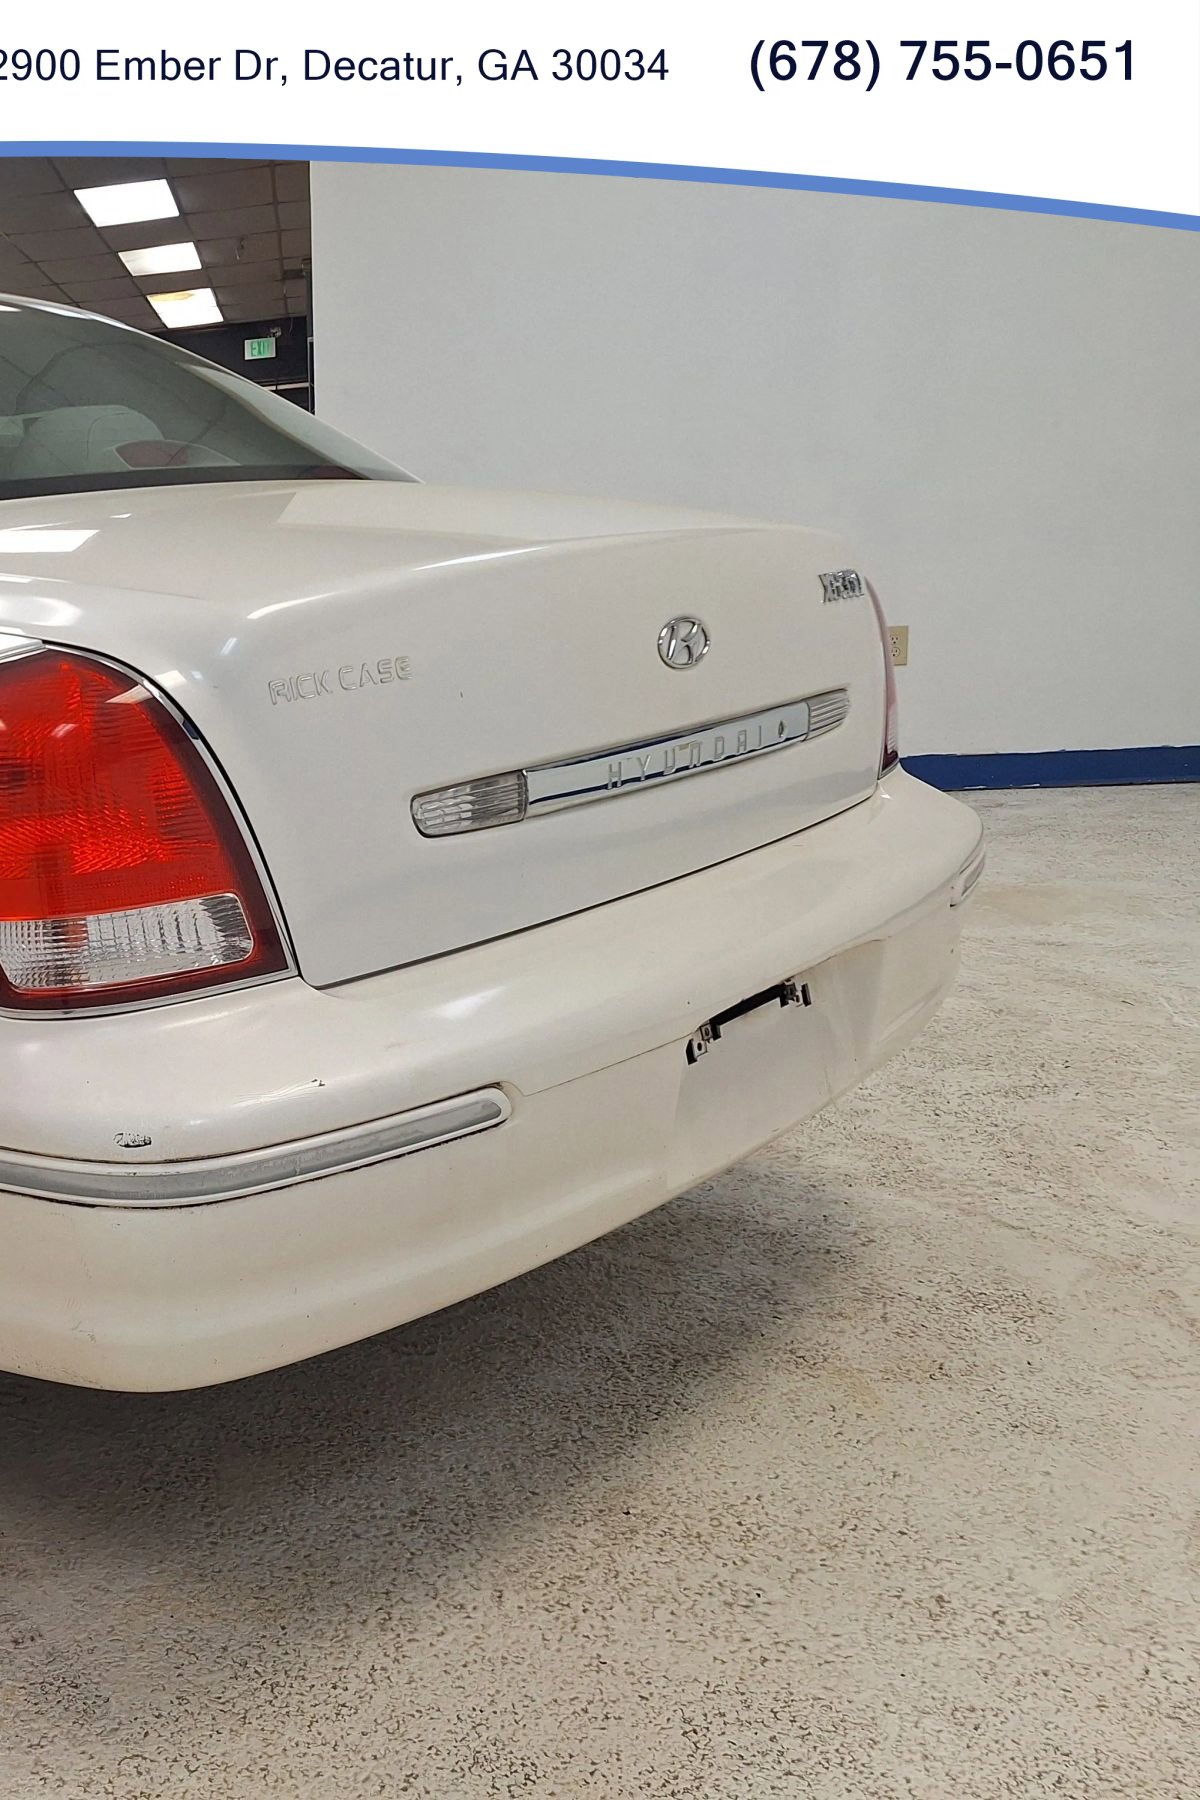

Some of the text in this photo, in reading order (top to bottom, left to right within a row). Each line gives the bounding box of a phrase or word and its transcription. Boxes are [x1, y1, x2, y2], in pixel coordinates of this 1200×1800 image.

[251, 340, 273, 357] EXIT
[268, 656, 411, 706] RICK CASE
[607, 724, 763, 790] HYUNDAI
